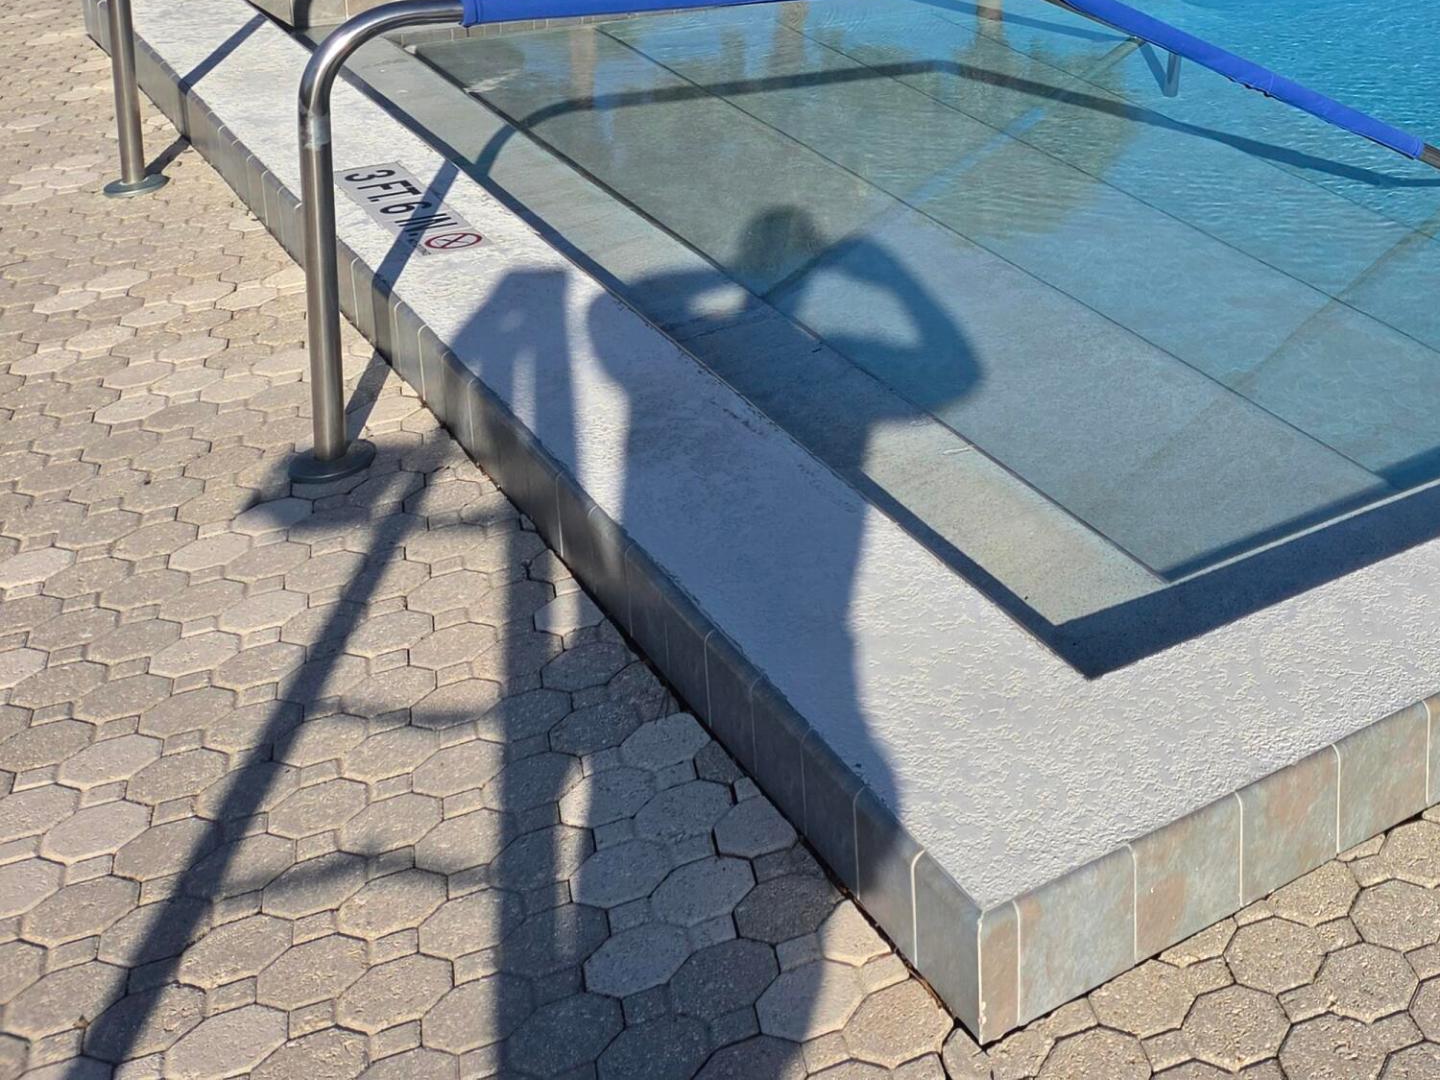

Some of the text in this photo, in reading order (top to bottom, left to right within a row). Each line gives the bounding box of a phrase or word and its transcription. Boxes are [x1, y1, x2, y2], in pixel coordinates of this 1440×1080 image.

[344, 169, 459, 236] 3 FT. 6 IN.
